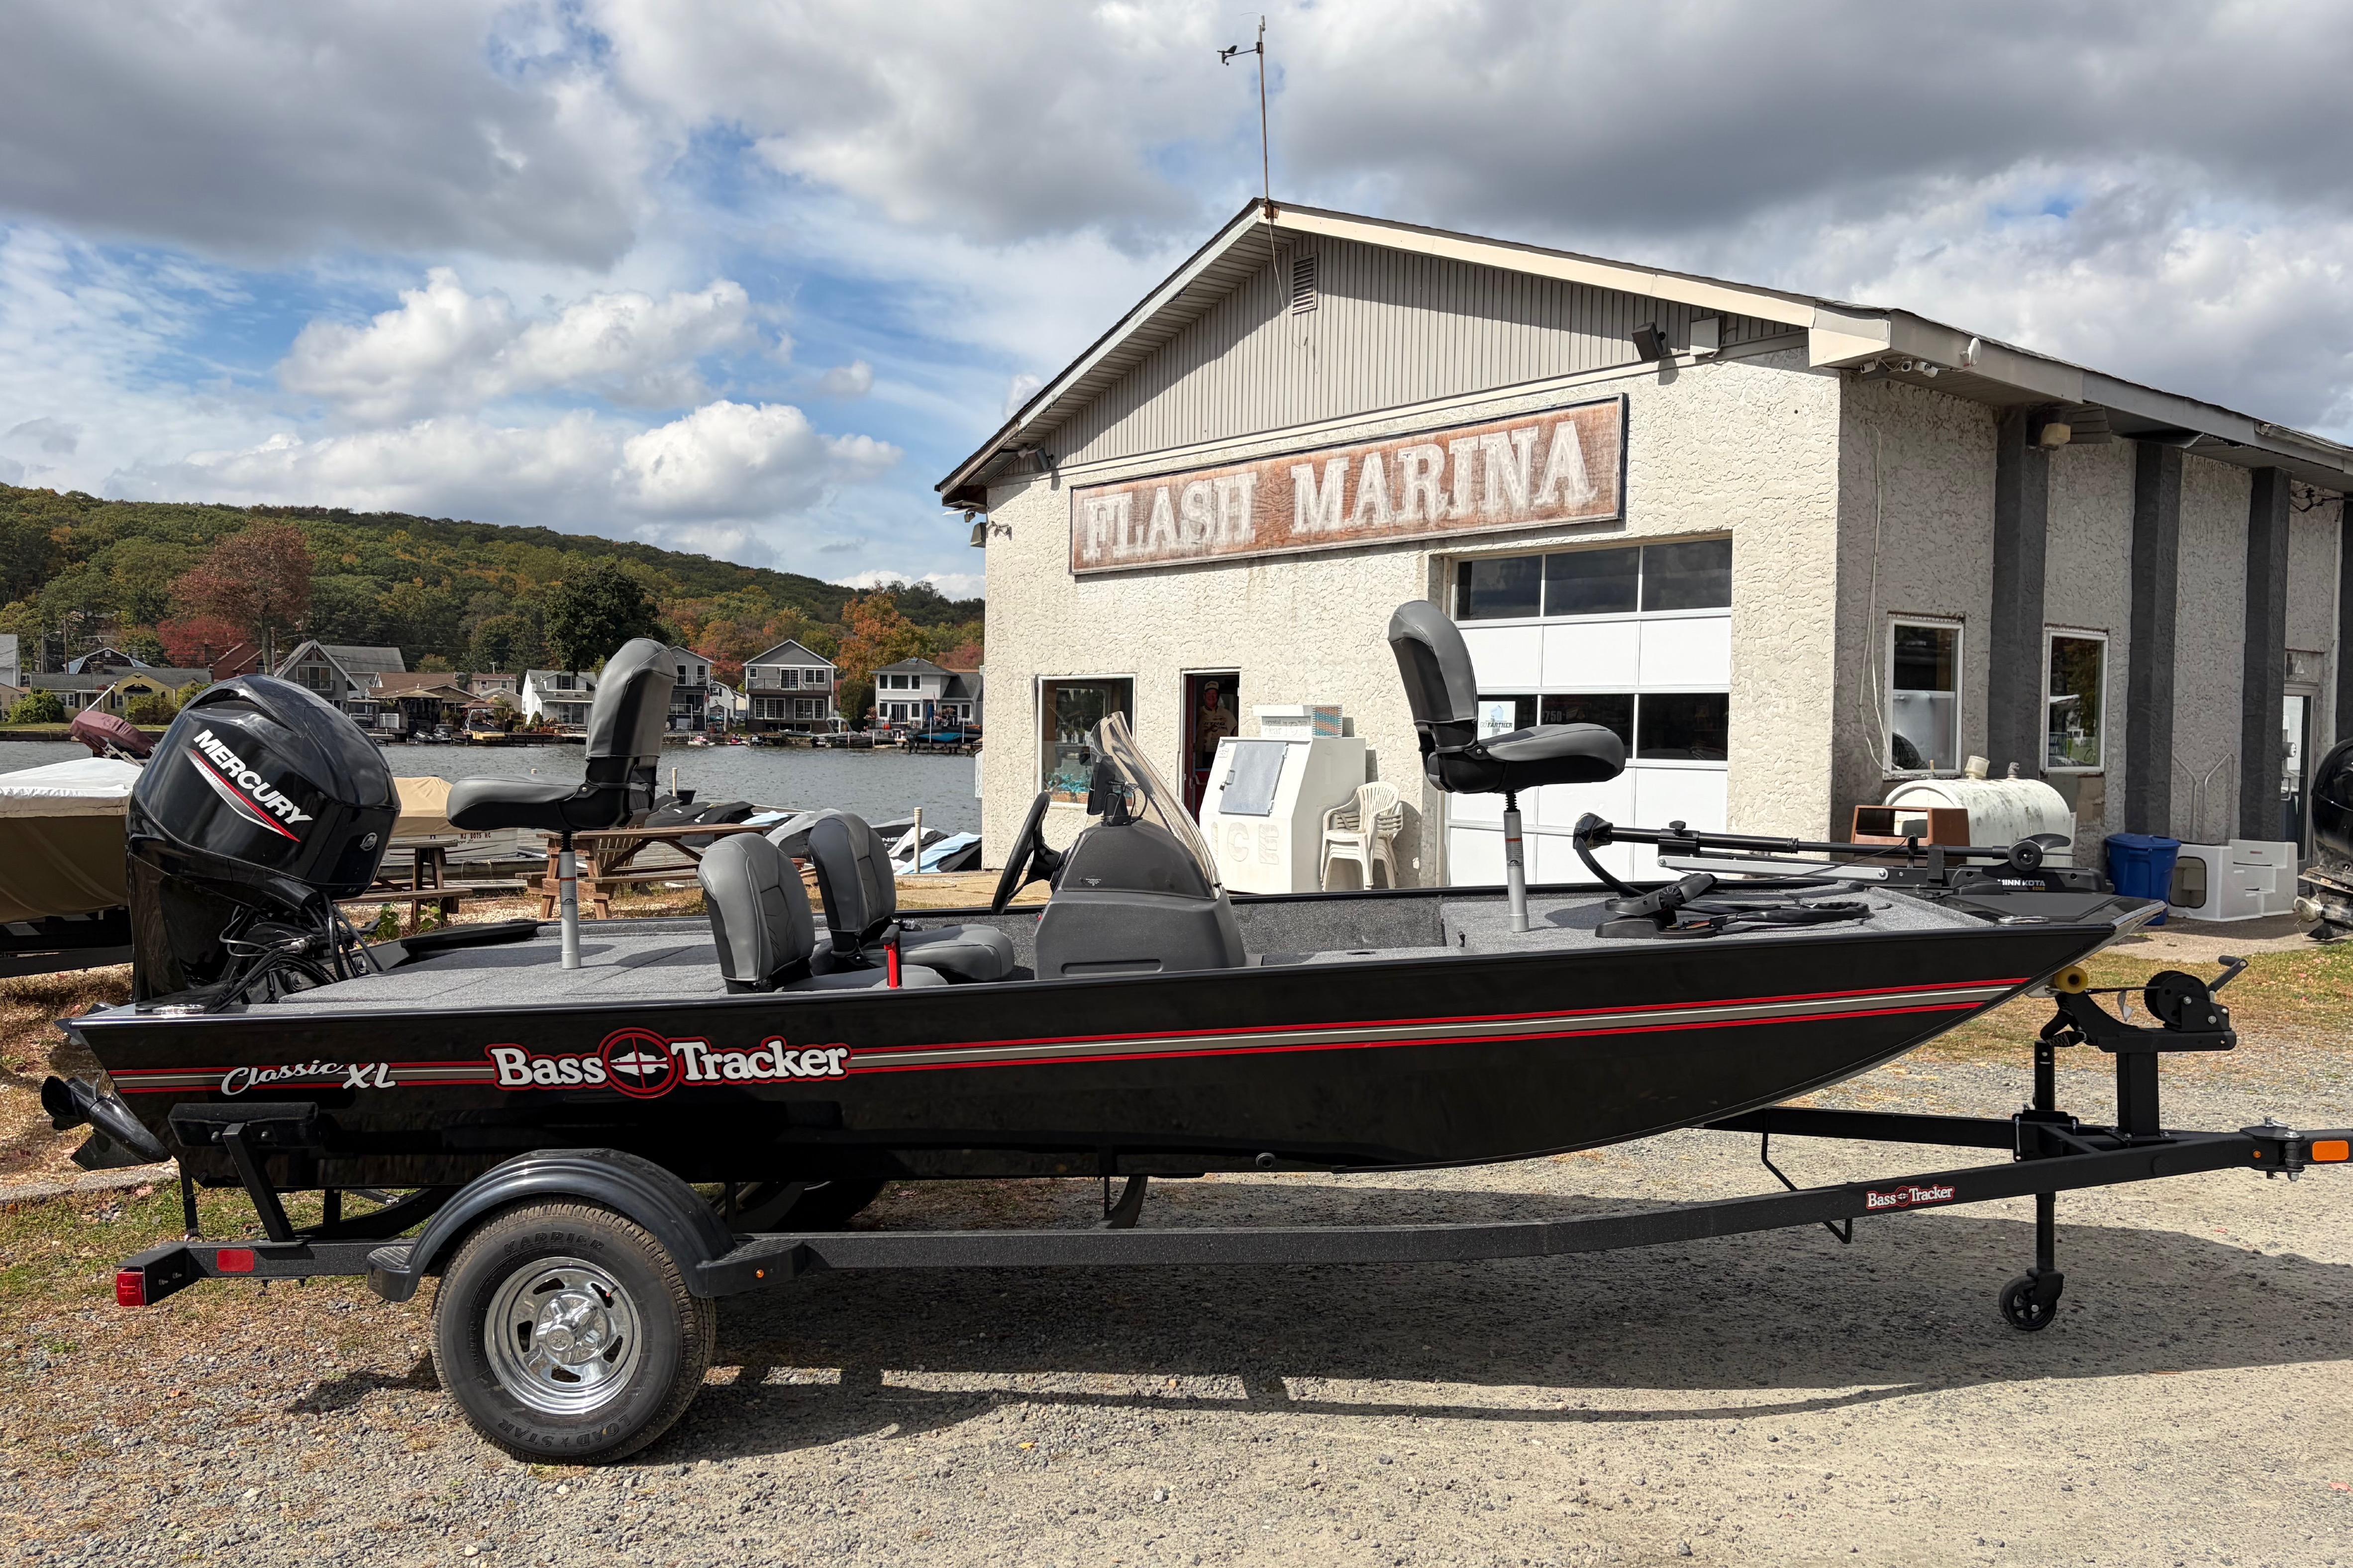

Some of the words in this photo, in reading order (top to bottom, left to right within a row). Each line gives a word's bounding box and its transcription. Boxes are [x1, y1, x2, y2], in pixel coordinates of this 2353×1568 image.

[1083, 473, 1256, 561] FLASH
[1291, 420, 1597, 534] MARINA
[194, 729, 313, 824] MERCURY
[1211, 822, 1279, 865] ICE
[221, 1060, 343, 1095] Classic
[343, 1063, 396, 1089] XL
[491, 1048, 607, 1085] Bass
[671, 1041, 848, 1080] Tracker
[1867, 1193, 1896, 1207] Bass
[1909, 1186, 1952, 1202] Tracker
[504, 1231, 605, 1257] KARRIER
[498, 1418, 554, 1447] STAR
[576, 1414, 631, 1447] LOAD
